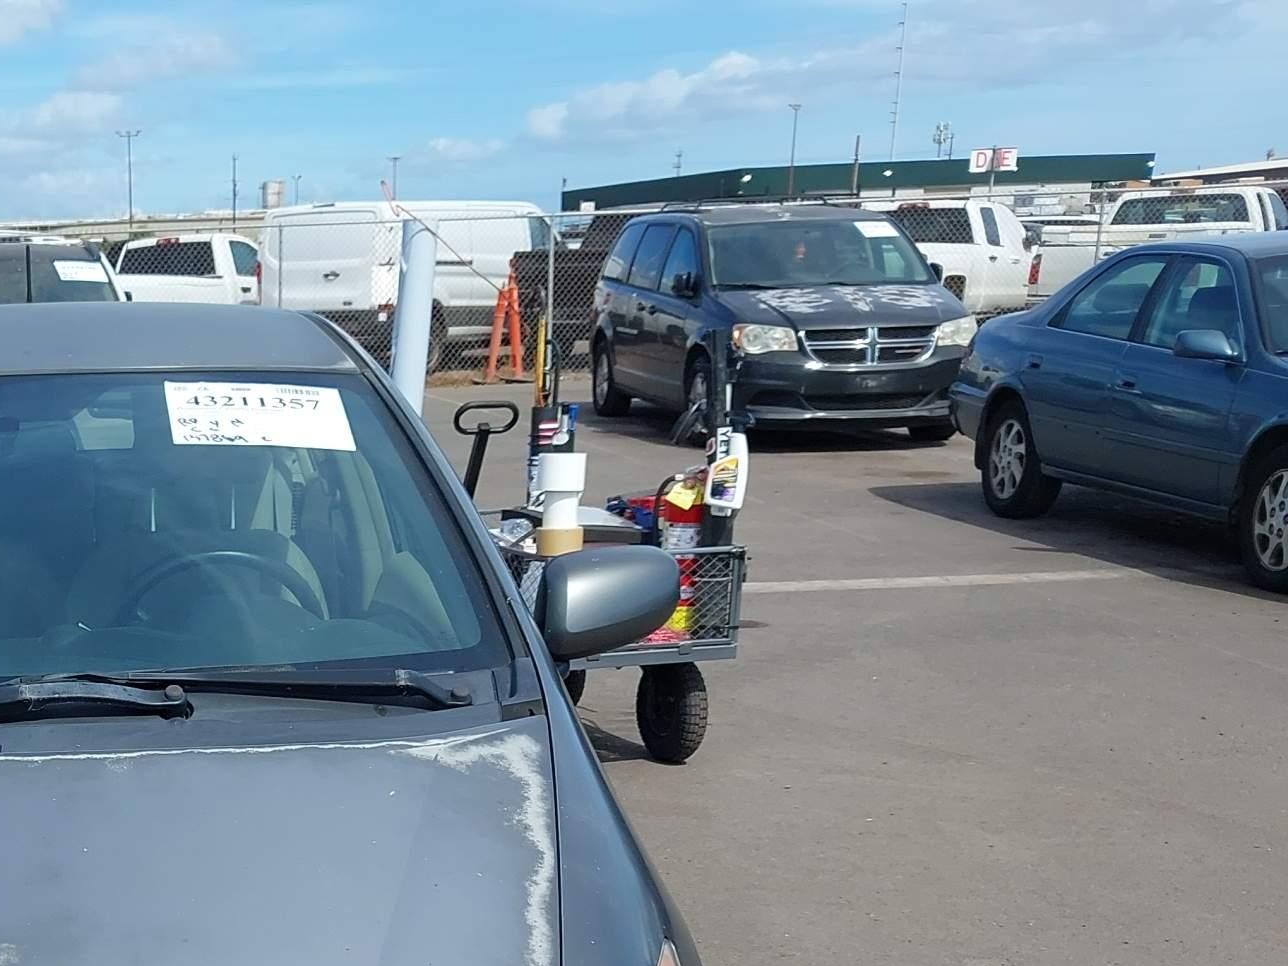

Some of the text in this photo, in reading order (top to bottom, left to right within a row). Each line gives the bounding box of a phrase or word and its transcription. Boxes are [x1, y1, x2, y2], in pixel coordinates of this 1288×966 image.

[976, 151, 1012, 168] D E
[186, 395, 319, 410] 43211357
[719, 429, 730, 459] YET
